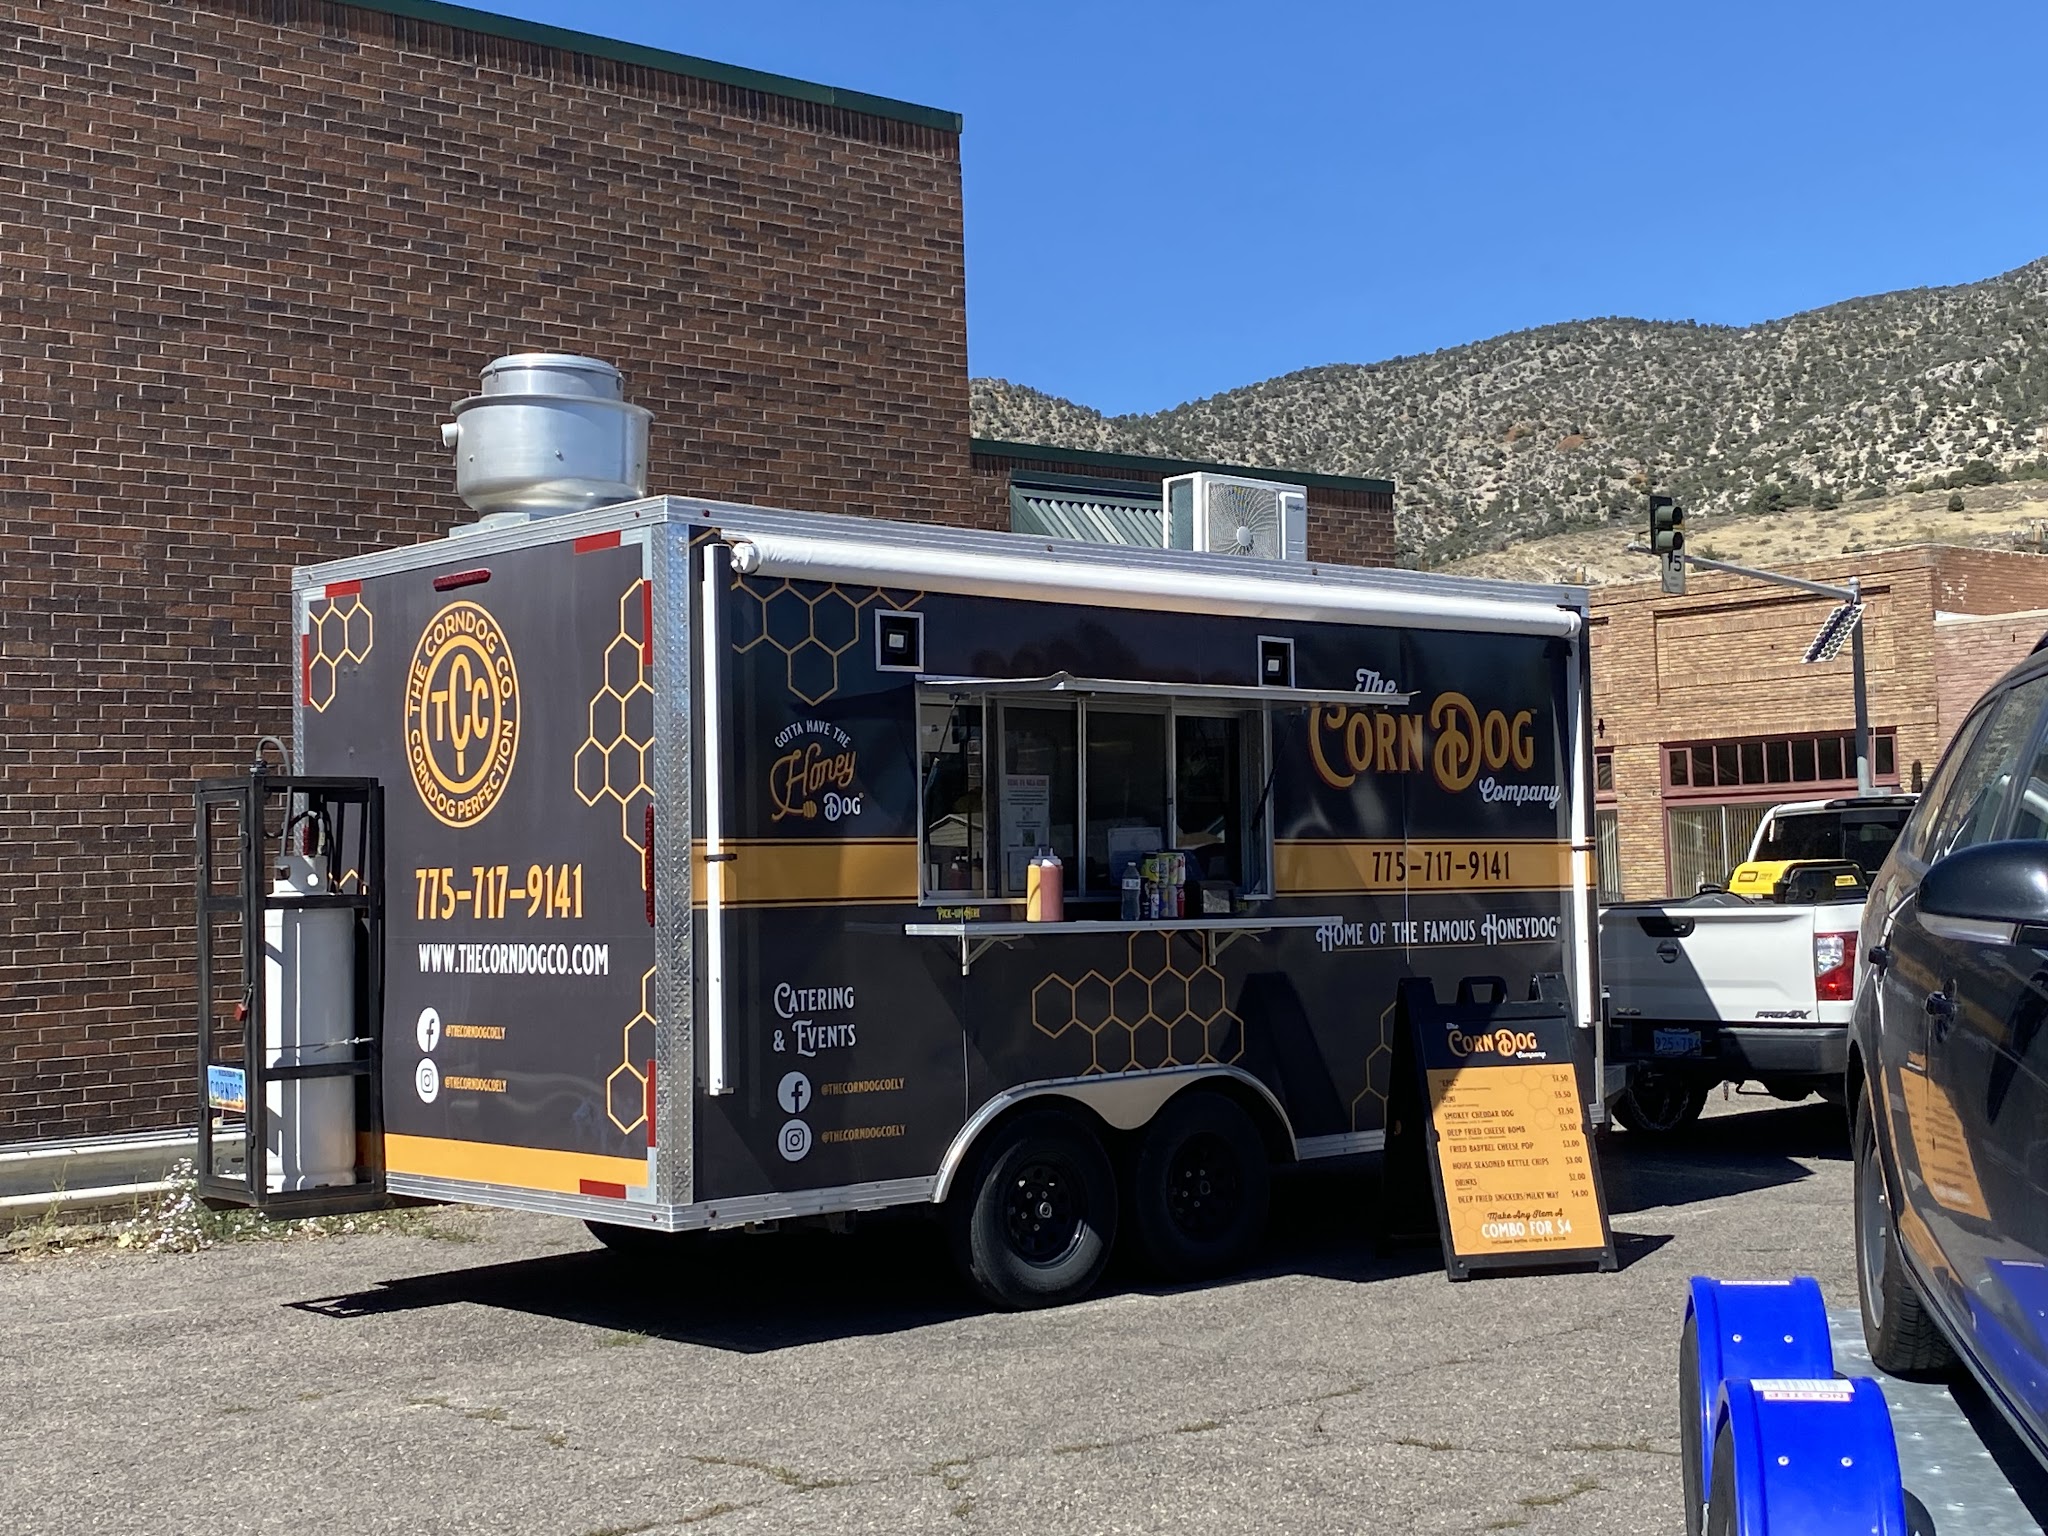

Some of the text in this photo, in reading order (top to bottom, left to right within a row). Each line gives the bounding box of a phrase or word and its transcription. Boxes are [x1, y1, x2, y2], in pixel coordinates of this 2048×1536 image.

[409, 611, 513, 717] THE CORNDOG CO.
[1355, 668, 1398, 693] The
[774, 720, 851, 748] GOTTA HAVE THE
[411, 719, 514, 819] CORNDOG PERFECTION
[770, 742, 857, 820] Honey
[1479, 776, 1561, 809] Company
[1372, 850, 1510, 882] 775-717-9141
[415, 863, 583, 920] 775-717-9141
[1369, 922, 1387, 944] OF
[1392, 921, 1418, 944] THE
[1423, 919, 1476, 942] FAMOUS
[418, 943, 609, 976] WWW.THECORNDOGCO.COM
[773, 1029, 786, 1052] &
[821, 1077, 905, 1096] @THECORNDOGCOELY
[1501, 1109, 1514, 1117] DOG
[821, 1124, 906, 1144] @THECORNDOGCOELY
[1487, 1211, 1512, 1220] Make
[1513, 1209, 1531, 1220] Any
[1481, 1219, 1572, 1238] COMBO FOR $4
